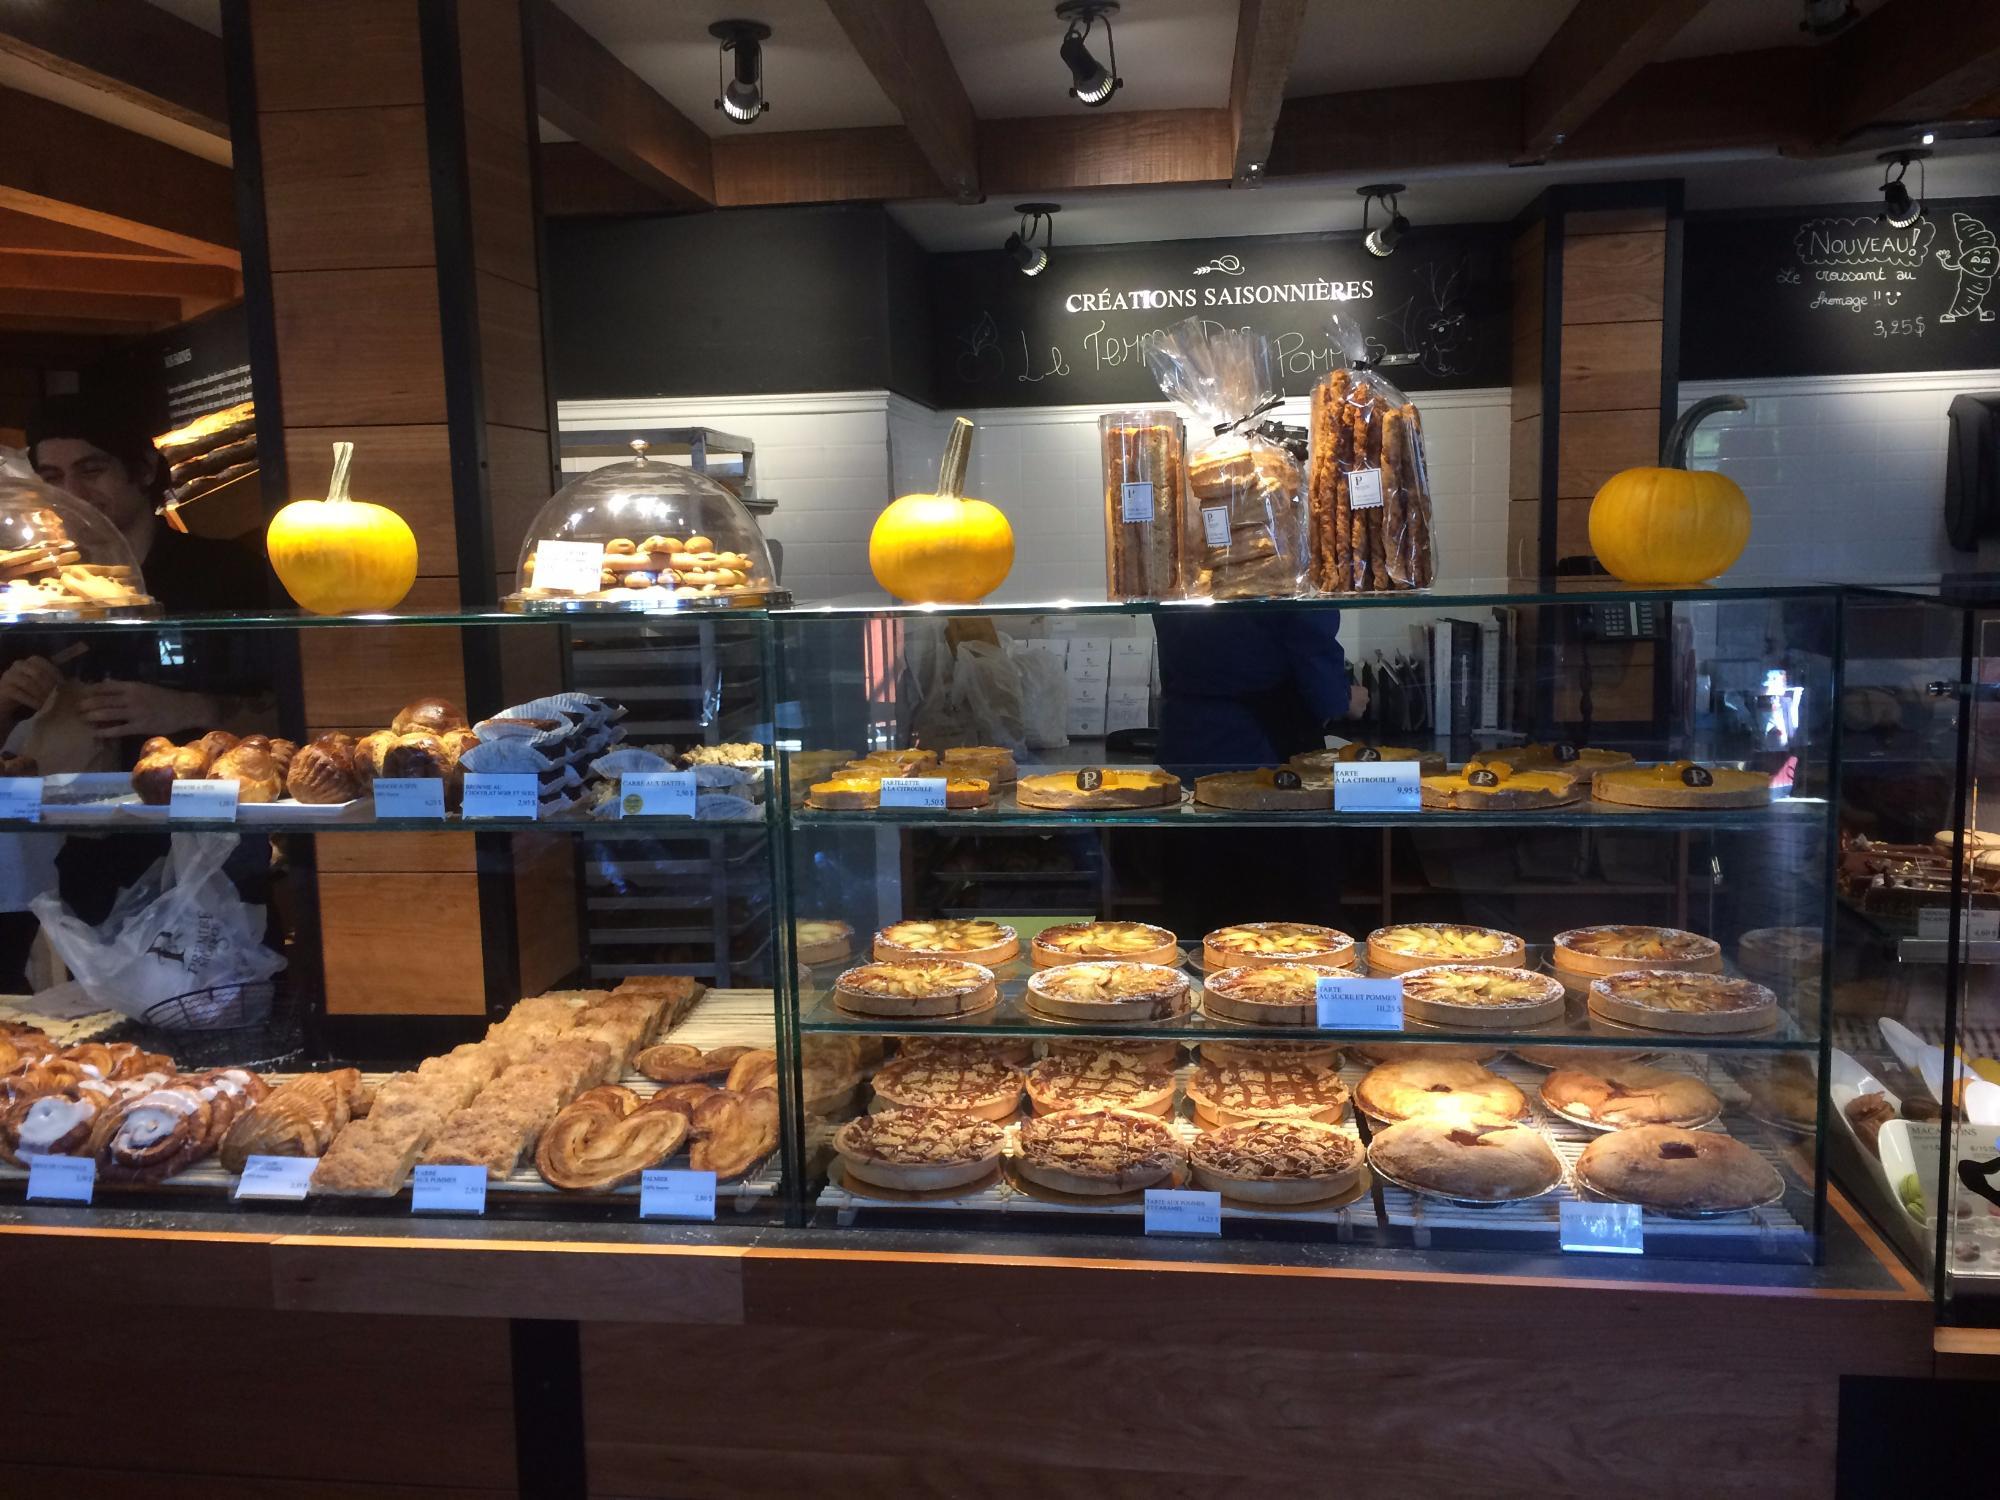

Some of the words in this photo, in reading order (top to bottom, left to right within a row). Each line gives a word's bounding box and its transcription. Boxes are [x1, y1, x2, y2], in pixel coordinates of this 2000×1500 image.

[1810, 228, 1921, 257] NOUVEAU!
[1896, 270, 1917, 281] au
[1066, 287, 1197, 313] CRÉATIONS
[1204, 277, 1374, 307] SAISONNIÈRES
[1810, 290, 1869, 313] fromage
[1018, 330, 1070, 382] Le
[1273, 332, 1388, 378] Pomms
